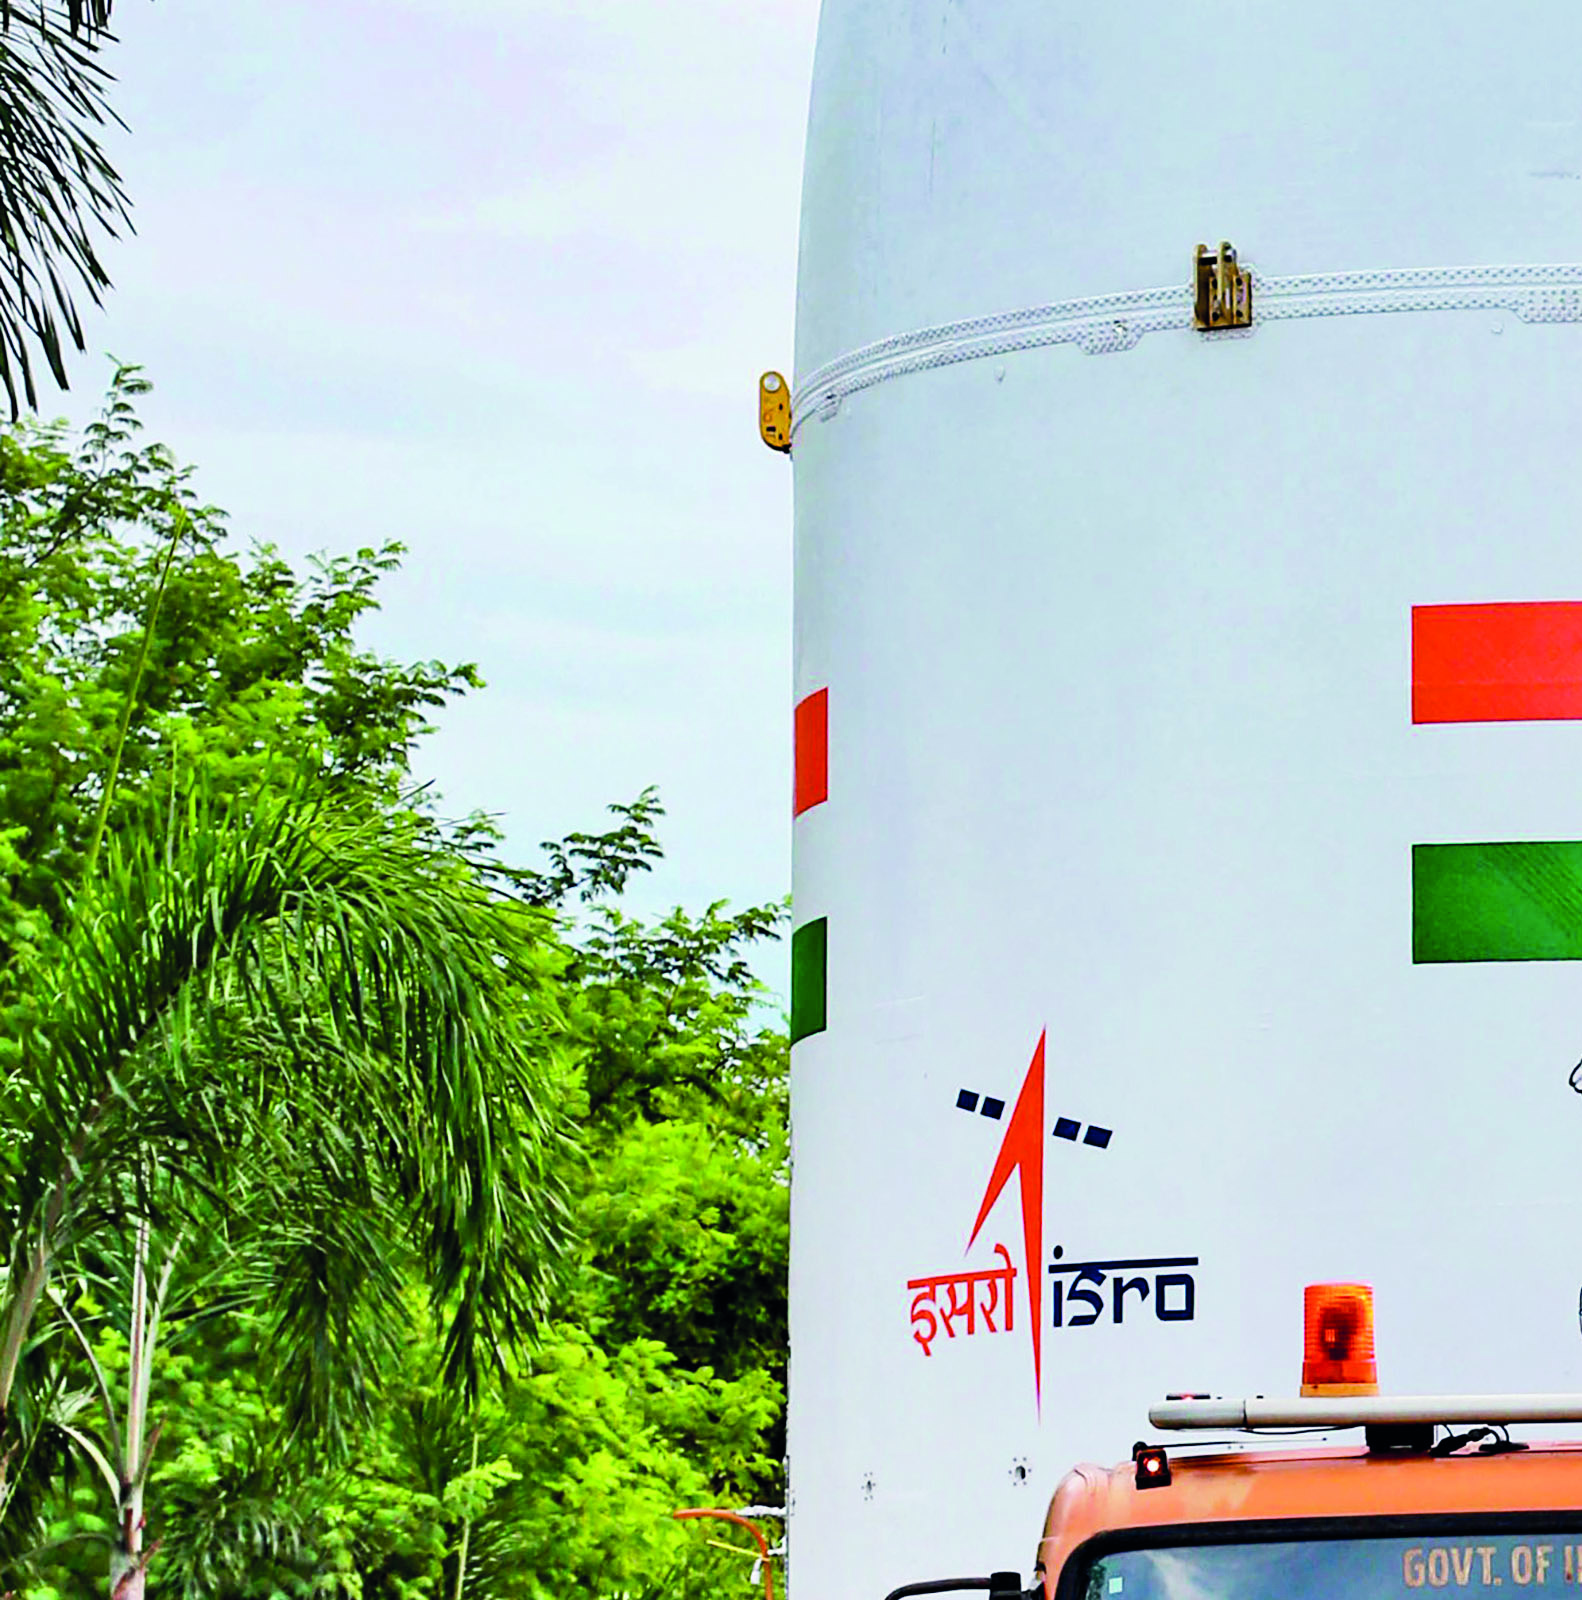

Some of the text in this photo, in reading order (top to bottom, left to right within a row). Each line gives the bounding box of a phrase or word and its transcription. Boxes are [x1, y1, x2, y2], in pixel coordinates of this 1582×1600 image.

[907, 1243, 1017, 1356] इसरो
[1403, 1546, 1502, 1587] GOVT.
[1511, 1545, 1552, 1584] OF
